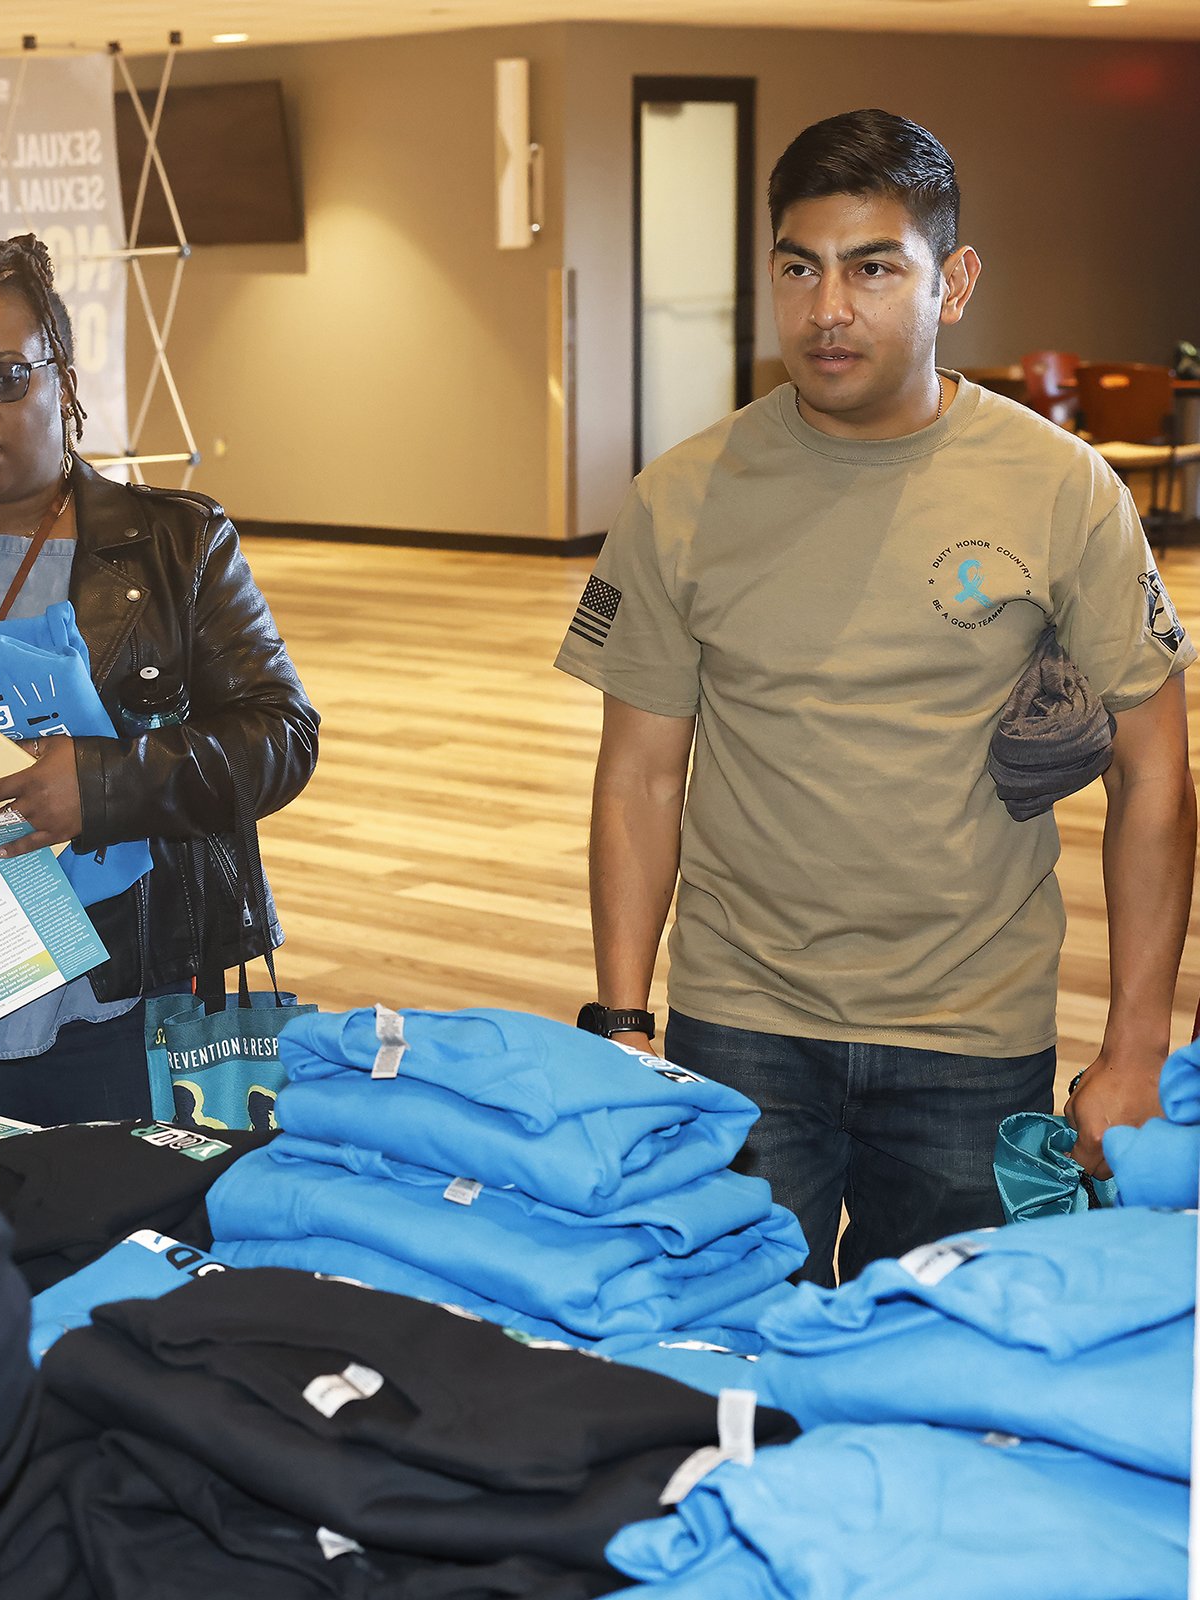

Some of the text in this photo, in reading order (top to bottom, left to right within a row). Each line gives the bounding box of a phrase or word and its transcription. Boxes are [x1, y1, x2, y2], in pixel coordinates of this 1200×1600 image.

[932, 539, 1032, 580] DUTY HONOR COUNTRY
[932, 599, 944, 611] BE
[941, 612, 949, 620] A
[950, 618, 977, 630] GOOD
[167, 1037, 280, 1070] REVENTION & RESP
